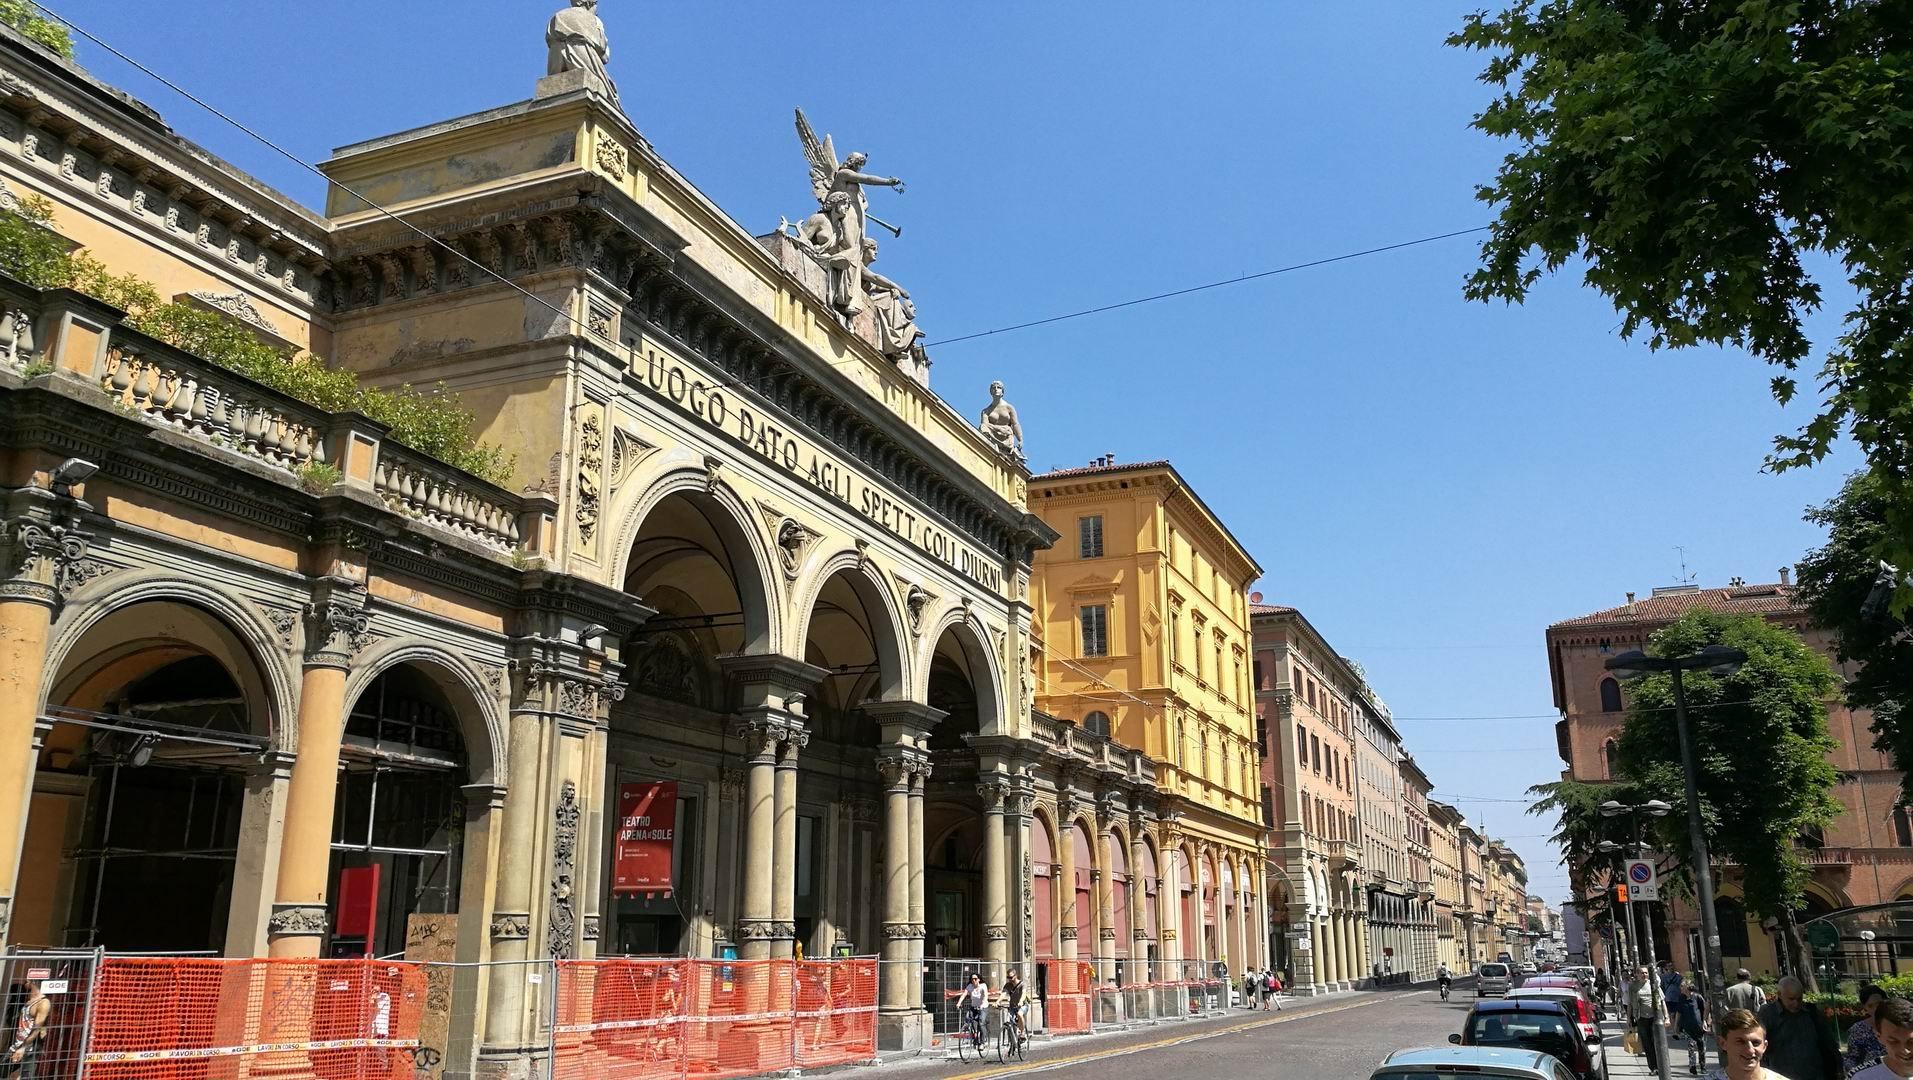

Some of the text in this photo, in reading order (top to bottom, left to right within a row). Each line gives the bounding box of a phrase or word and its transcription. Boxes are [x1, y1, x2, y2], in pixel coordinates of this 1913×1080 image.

[629, 338, 726, 428] LUOGO
[739, 408, 799, 471] DATO
[808, 455, 851, 504] AGLI
[961, 548, 1001, 594] DIURNI
[621, 816, 651, 828] TEATRO
[620, 830, 647, 841] ARENA
[652, 829, 673, 840] SOLE
[103, 1053, 126, 1061] CORSO
